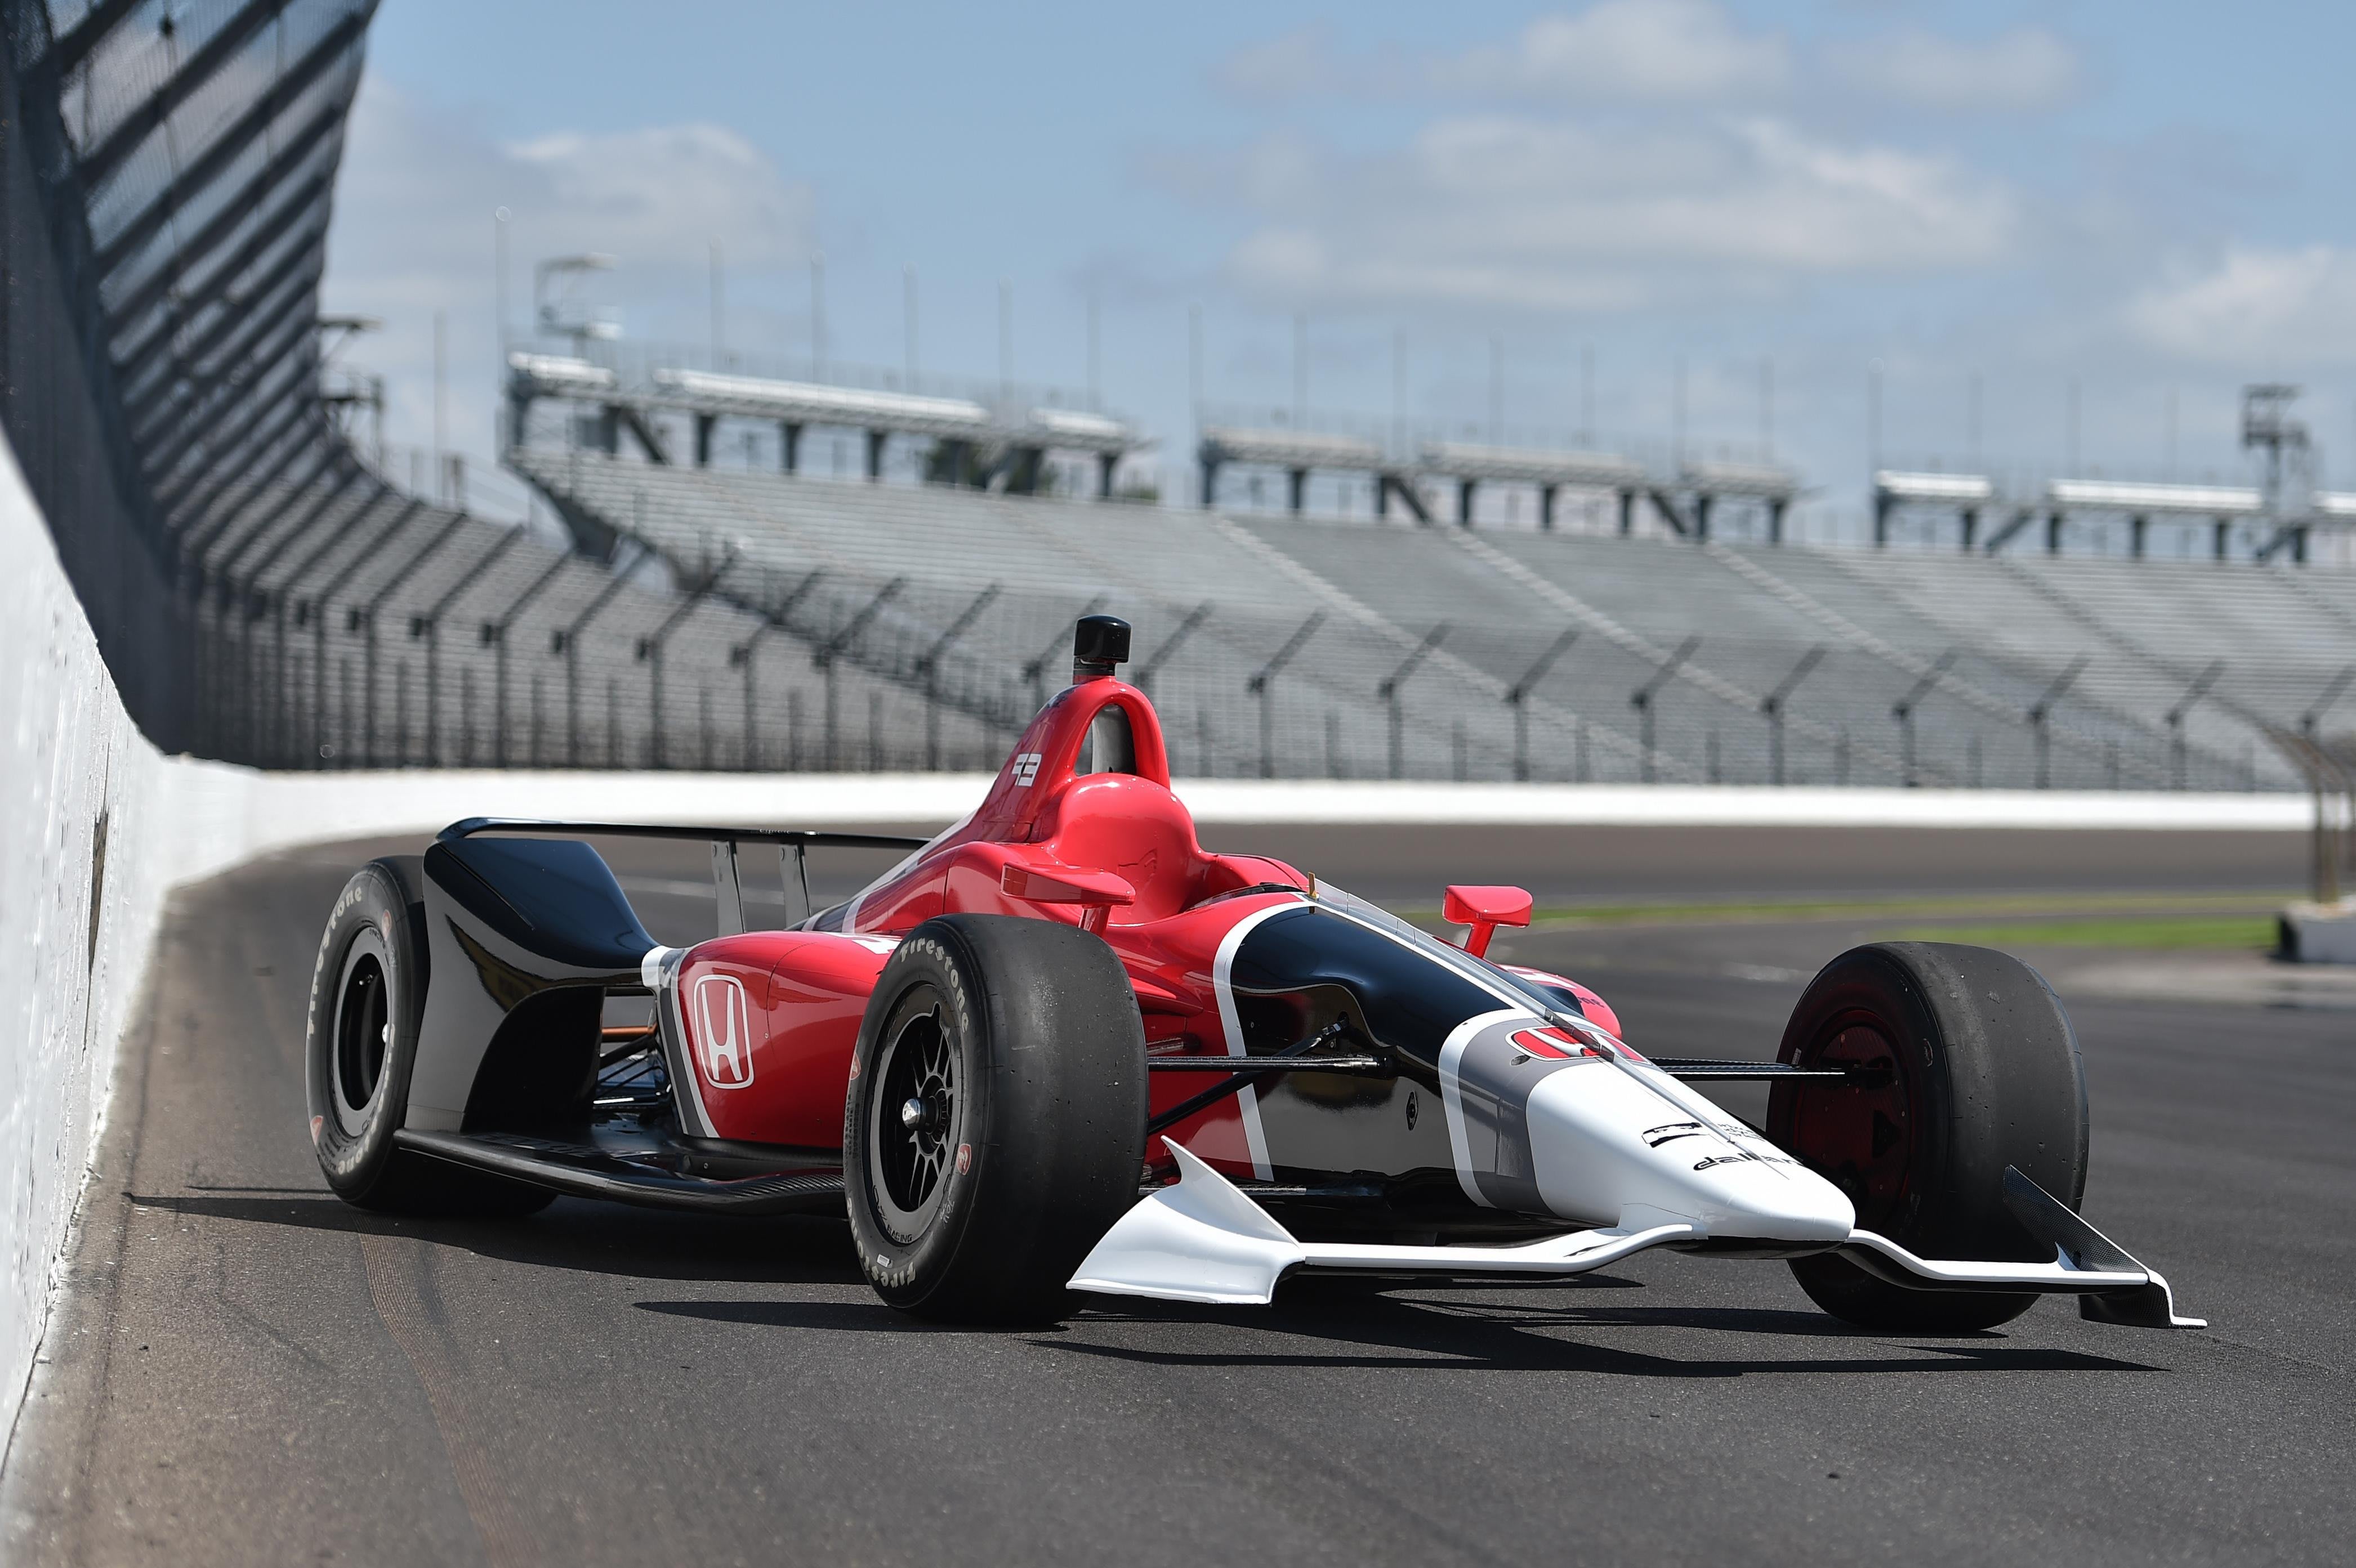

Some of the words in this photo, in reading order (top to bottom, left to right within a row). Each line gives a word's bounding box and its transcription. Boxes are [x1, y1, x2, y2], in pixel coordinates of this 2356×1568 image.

[899, 937, 969, 1033] Firestone
[847, 1198, 916, 1288] Firestone
[886, 1223, 913, 1243] RACING
